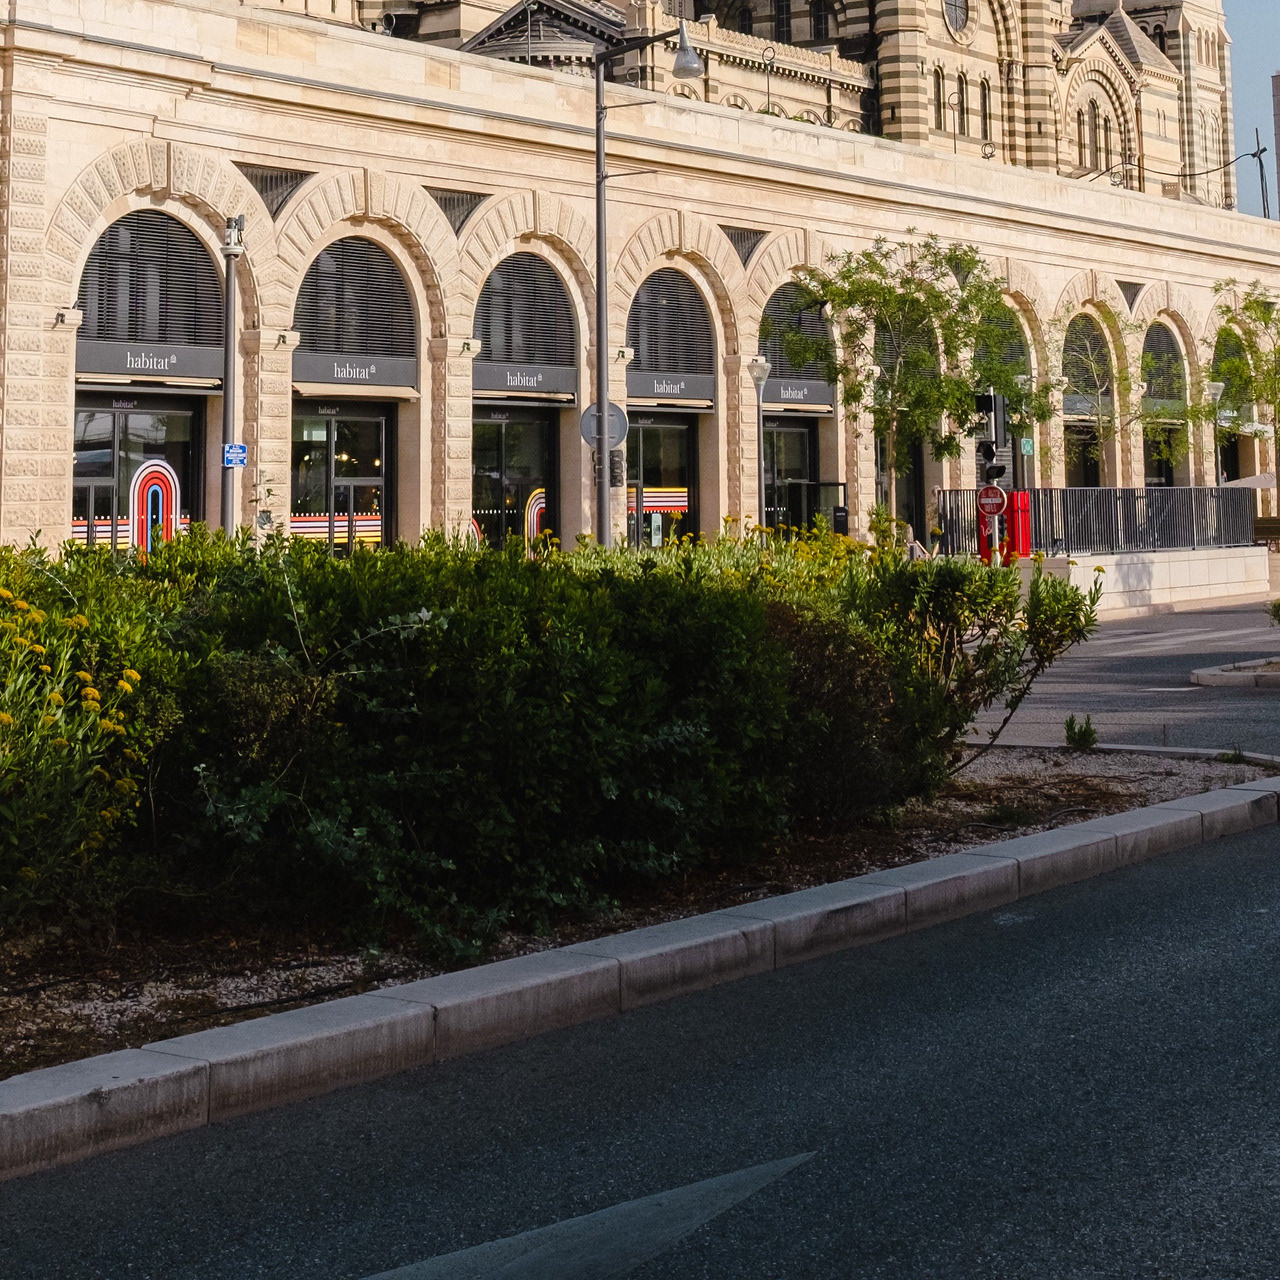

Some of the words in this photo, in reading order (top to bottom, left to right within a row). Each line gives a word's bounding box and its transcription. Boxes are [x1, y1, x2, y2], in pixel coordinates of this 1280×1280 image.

[126, 351, 170, 370] habitat
[333, 362, 370, 379] habitat
[506, 371, 537, 387] habitat
[654, 379, 680, 394] habitat
[780, 386, 804, 399] habitat
